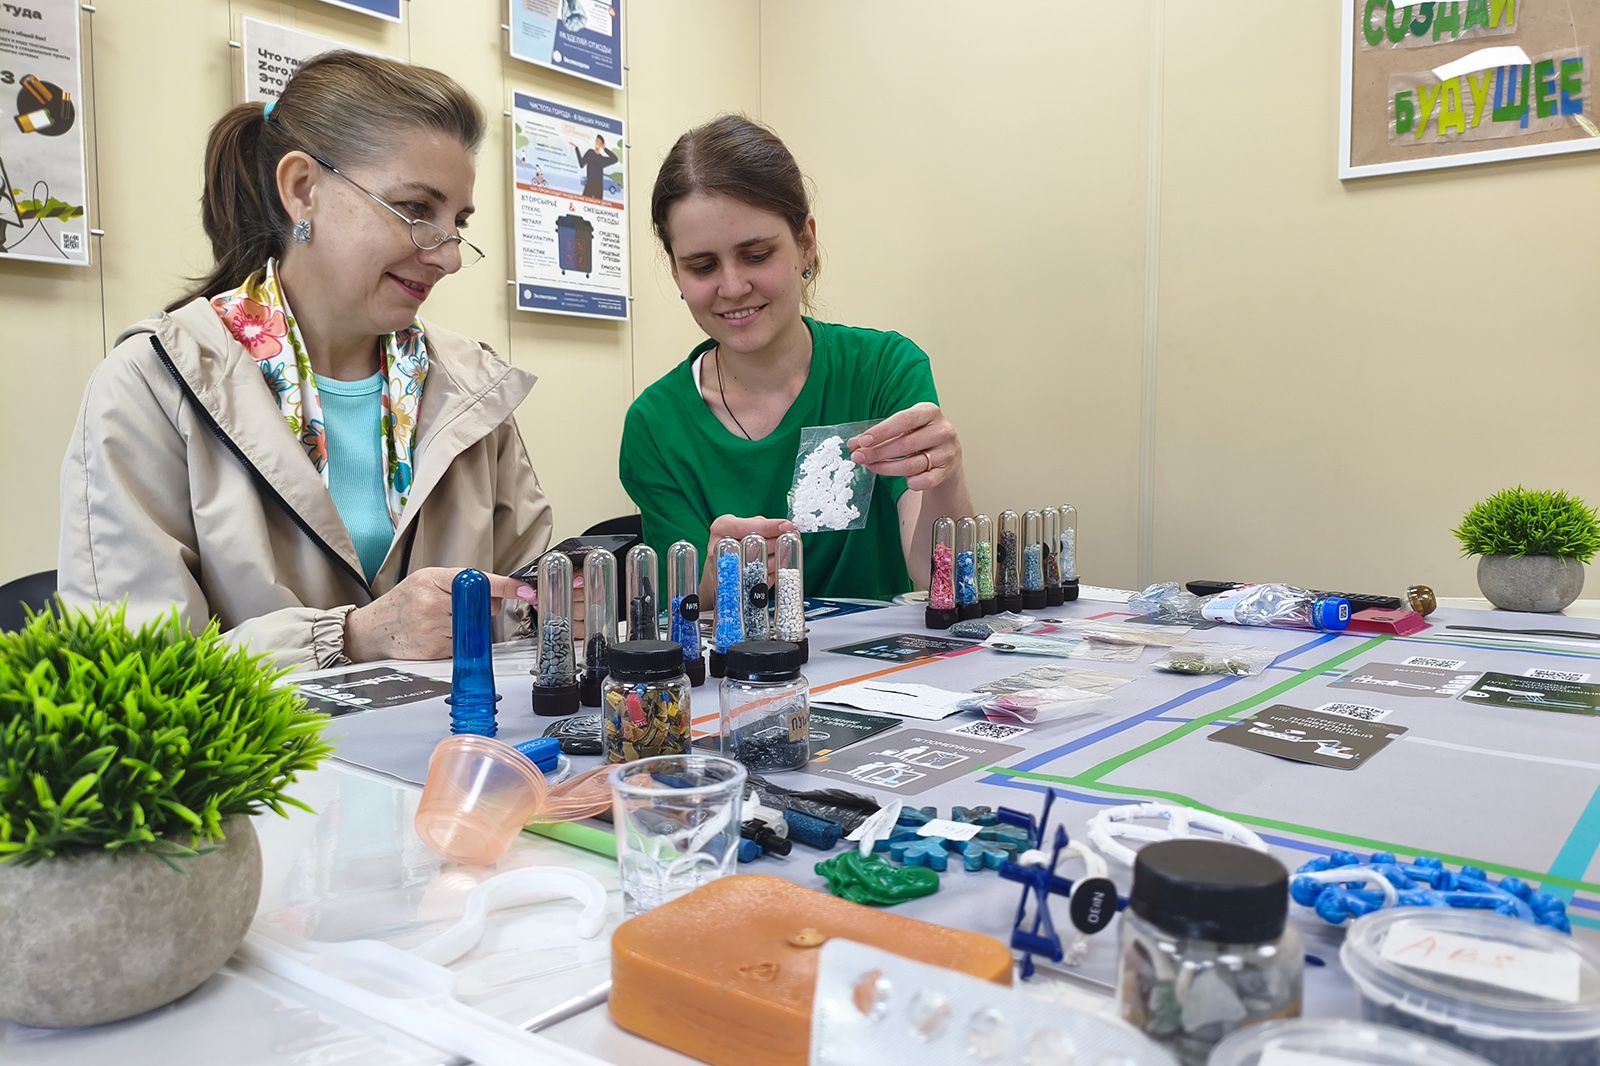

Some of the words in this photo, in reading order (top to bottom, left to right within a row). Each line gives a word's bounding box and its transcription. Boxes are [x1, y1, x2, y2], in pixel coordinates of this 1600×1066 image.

[3, 3, 42, 20] туда
[258, 47, 282, 62] Что
[258, 60, 289, 76] Zero
[259, 72, 283, 87] Это
[1394, 57, 1584, 140] БУДУЩЕЕ
[911, 737, 986, 754] АГЛОМЕРАЦИЯ
